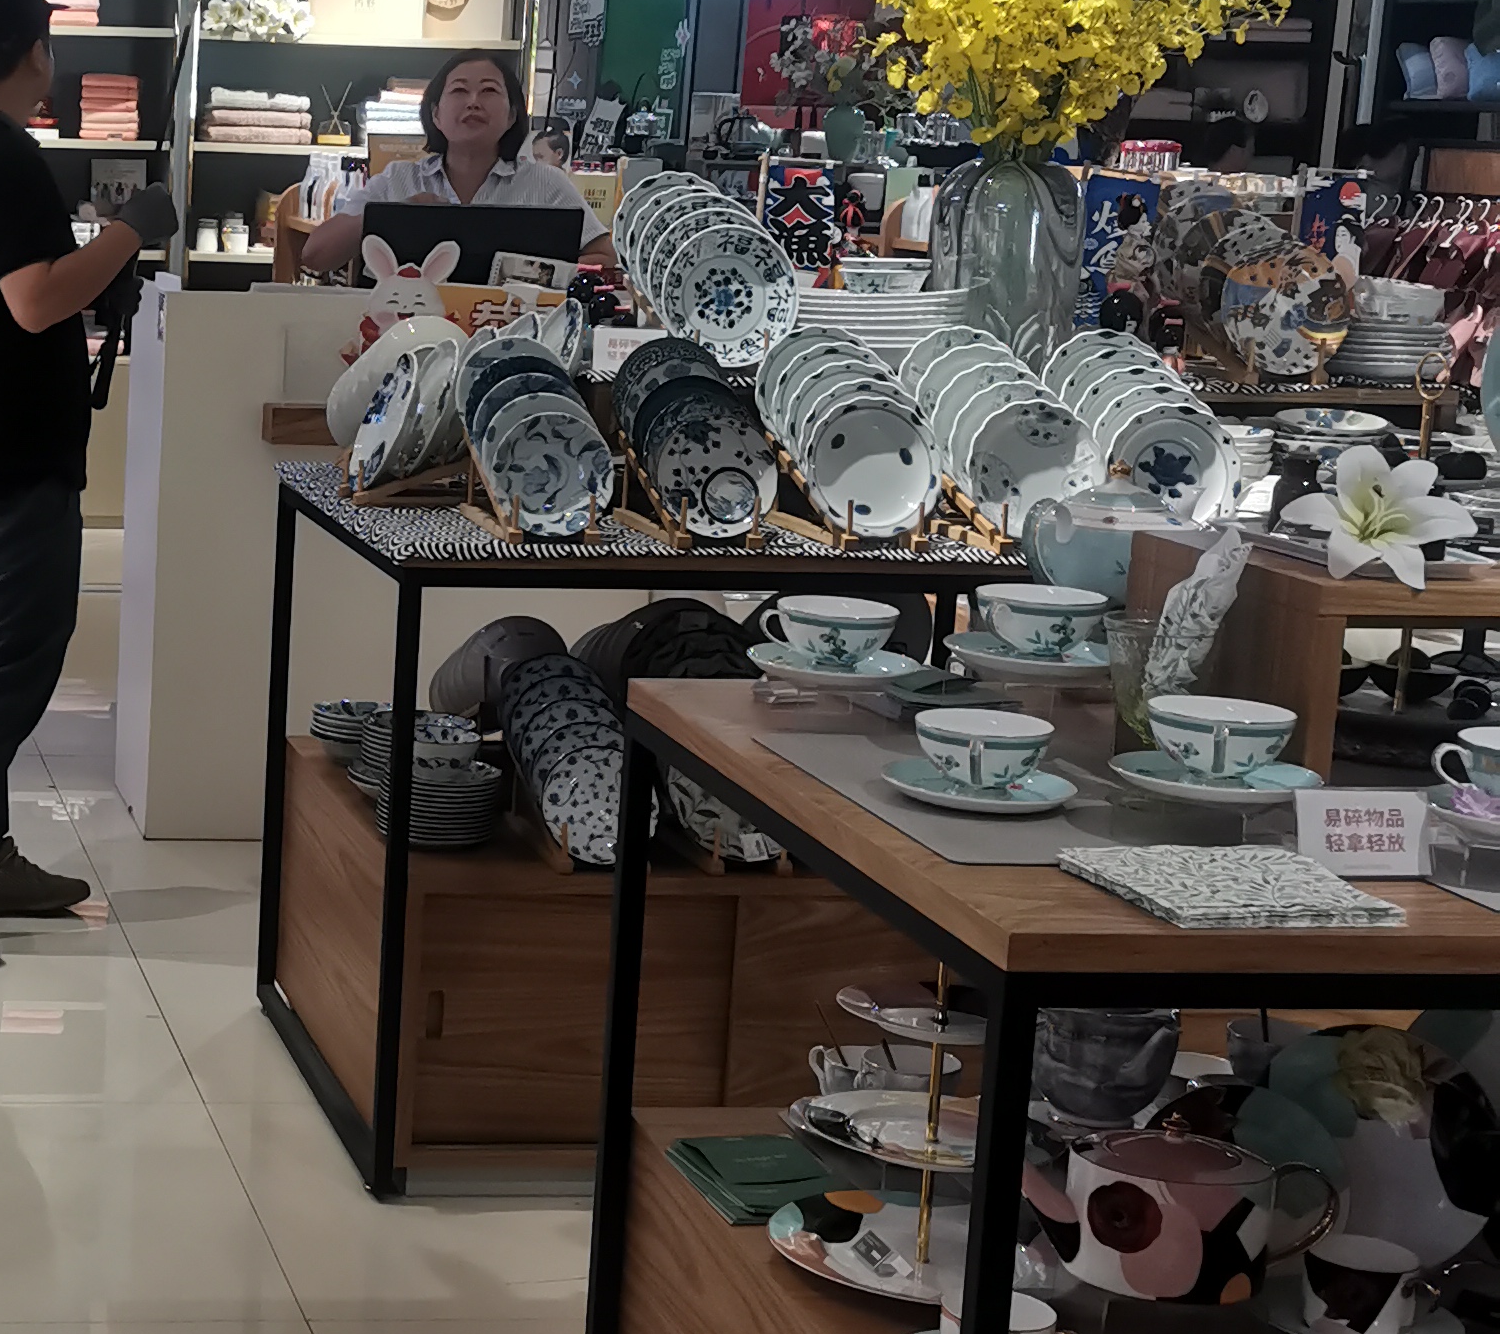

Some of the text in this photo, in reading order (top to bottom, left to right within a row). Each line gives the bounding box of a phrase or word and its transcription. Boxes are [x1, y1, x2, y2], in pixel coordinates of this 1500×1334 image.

[1324, 808, 1405, 828] 易碎物品
[1324, 832, 1407, 853] 轻拿轻放
